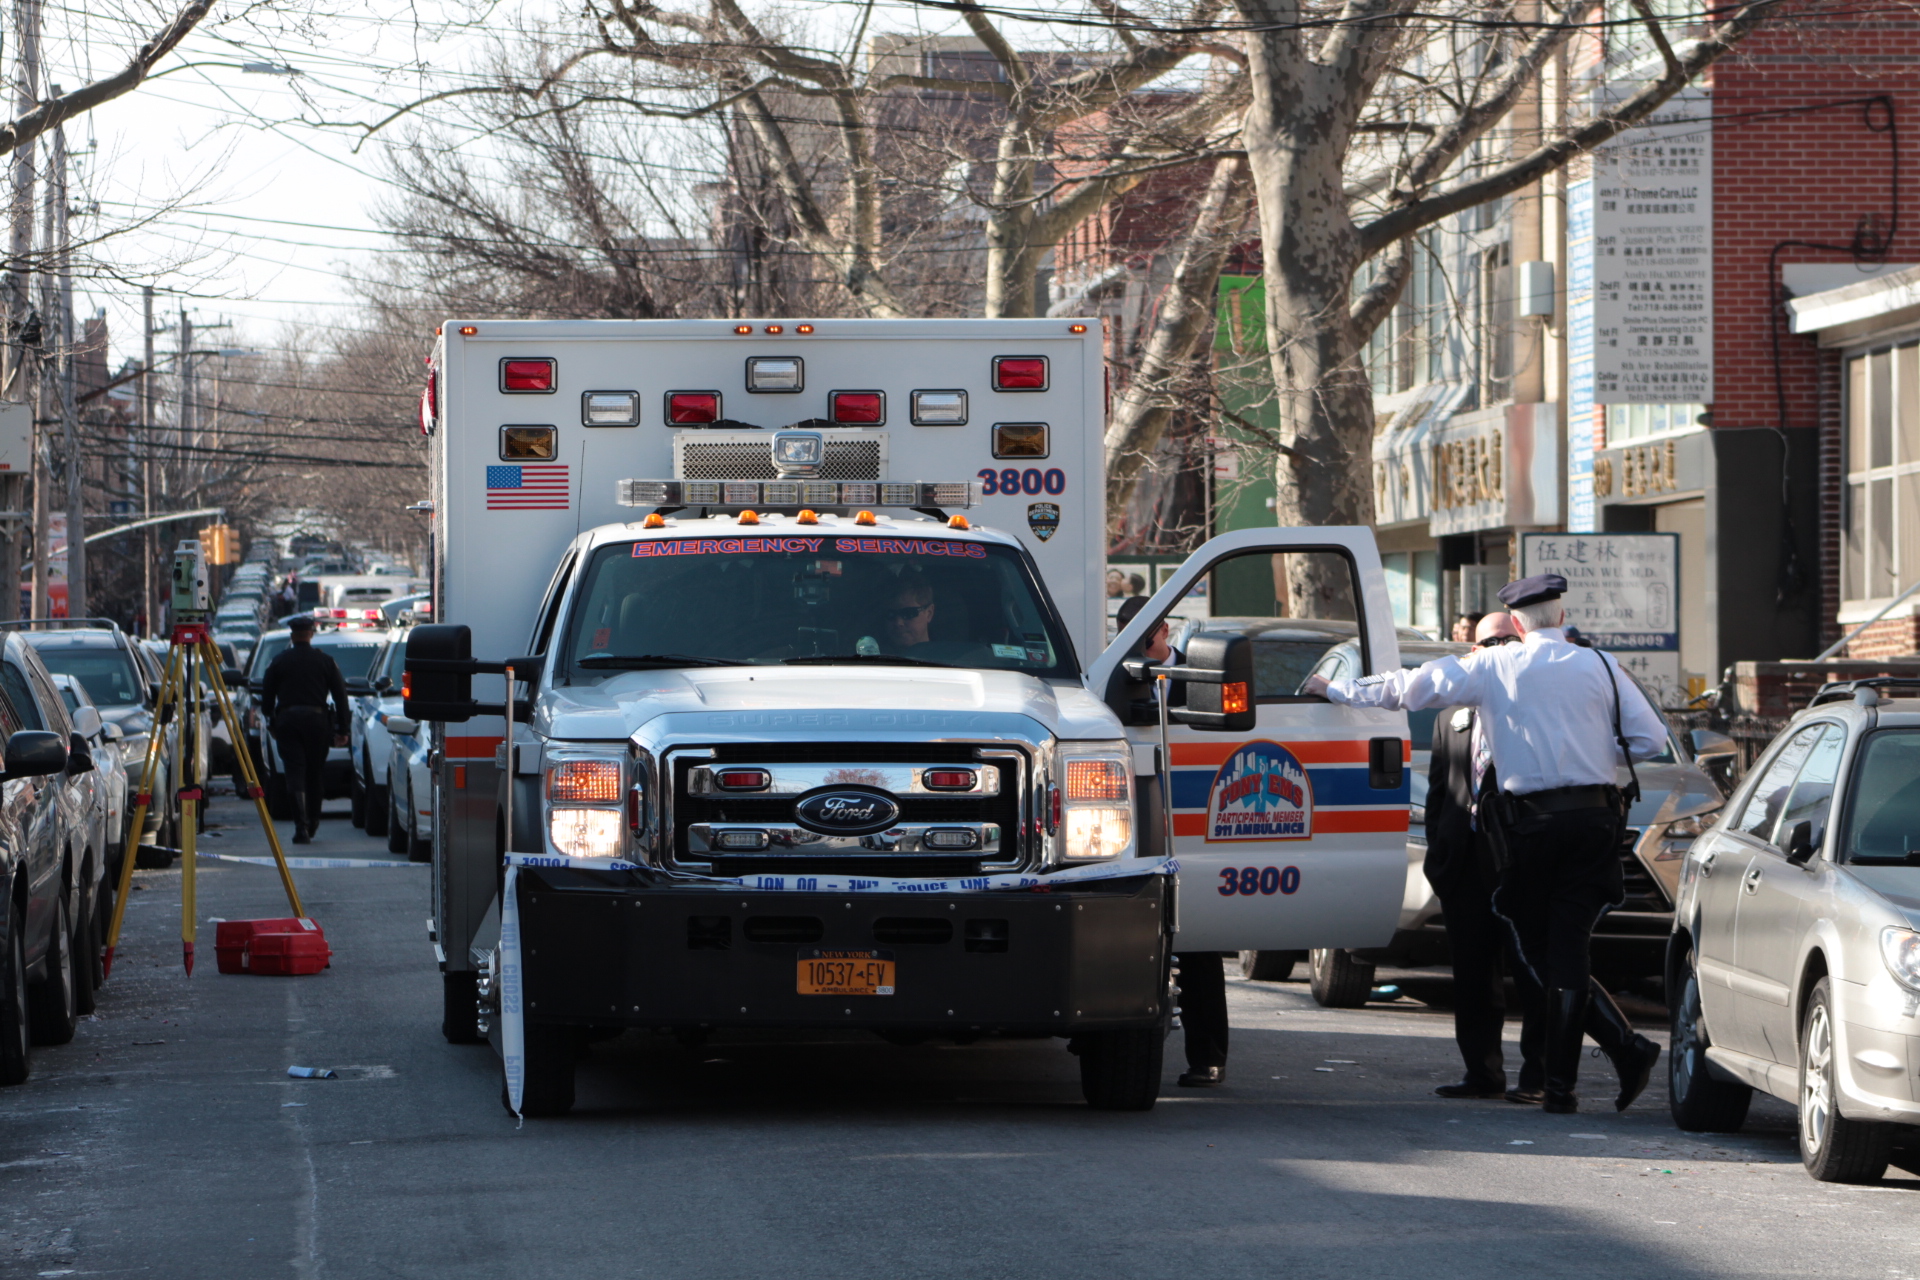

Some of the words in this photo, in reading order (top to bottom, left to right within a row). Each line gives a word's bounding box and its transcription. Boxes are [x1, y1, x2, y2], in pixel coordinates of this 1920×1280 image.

[1624, 187, 1658, 199] X-Treme
[1627, 325, 1654, 334] James
[977, 468, 1066, 496] 3800
[632, 538, 825, 557] EMERGENCY
[836, 538, 987, 558] SERVICES
[1537, 539, 1618, 564] 伍建林
[1585, 608, 1634, 619] FLOOR
[1219, 773, 1262, 812] FDNY
[1267, 773, 1303, 809] EMS
[820, 797, 875, 820] Ford
[1215, 812, 1271, 824] PARTICIPATING
[1272, 811, 1305, 823] MEMBER
[1215, 824, 1232, 836] 911
[1234, 823, 1305, 835] AMBULANCE
[960, 878, 990, 890] LINE
[1218, 866, 1300, 896] 3800
[847, 951, 871, 959] YORK
[809, 962, 854, 986] 10537
